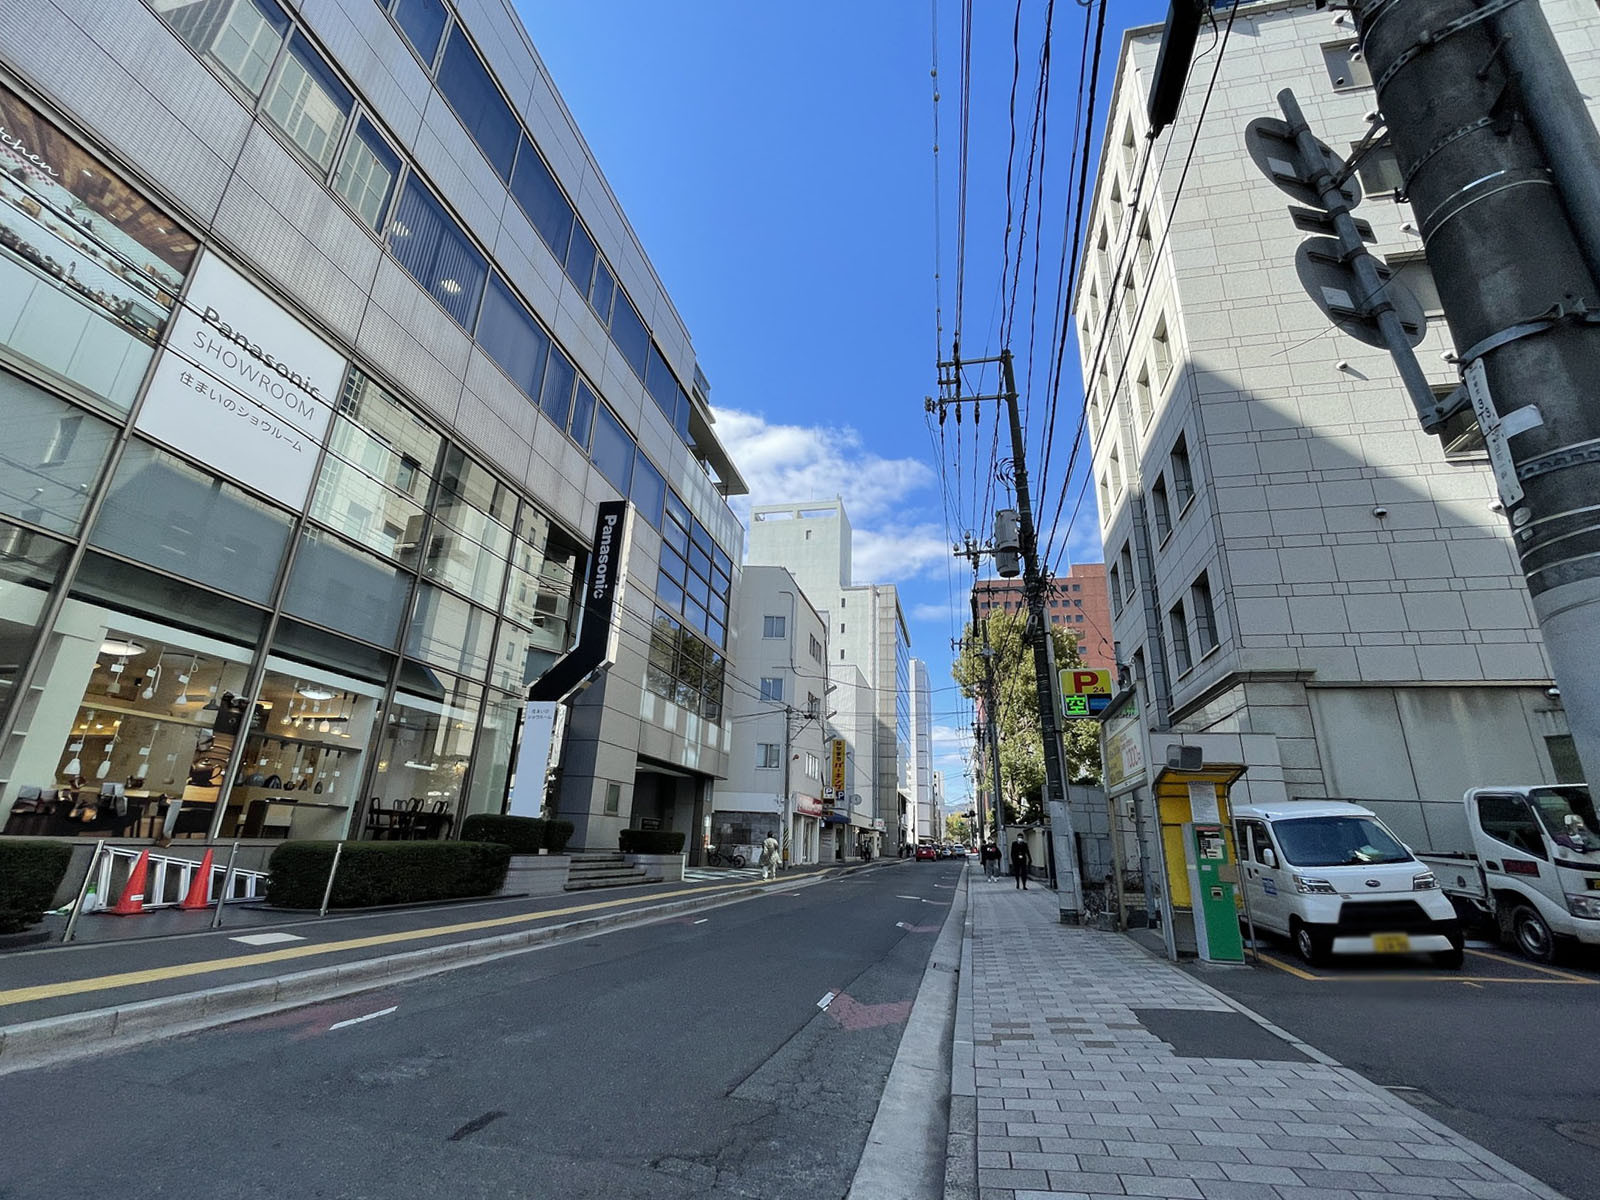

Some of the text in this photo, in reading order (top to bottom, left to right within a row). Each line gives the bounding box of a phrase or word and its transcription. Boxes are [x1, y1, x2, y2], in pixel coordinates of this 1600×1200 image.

[193, 331, 315, 420] SHOWROOM
[202, 306, 320, 399] Panasonic
[179, 371, 302, 453] 住まいのショウルーム
[593, 514, 618, 599] Panasonic
[1065, 695, 1088, 714] 空
[1073, 671, 1099, 694] P
